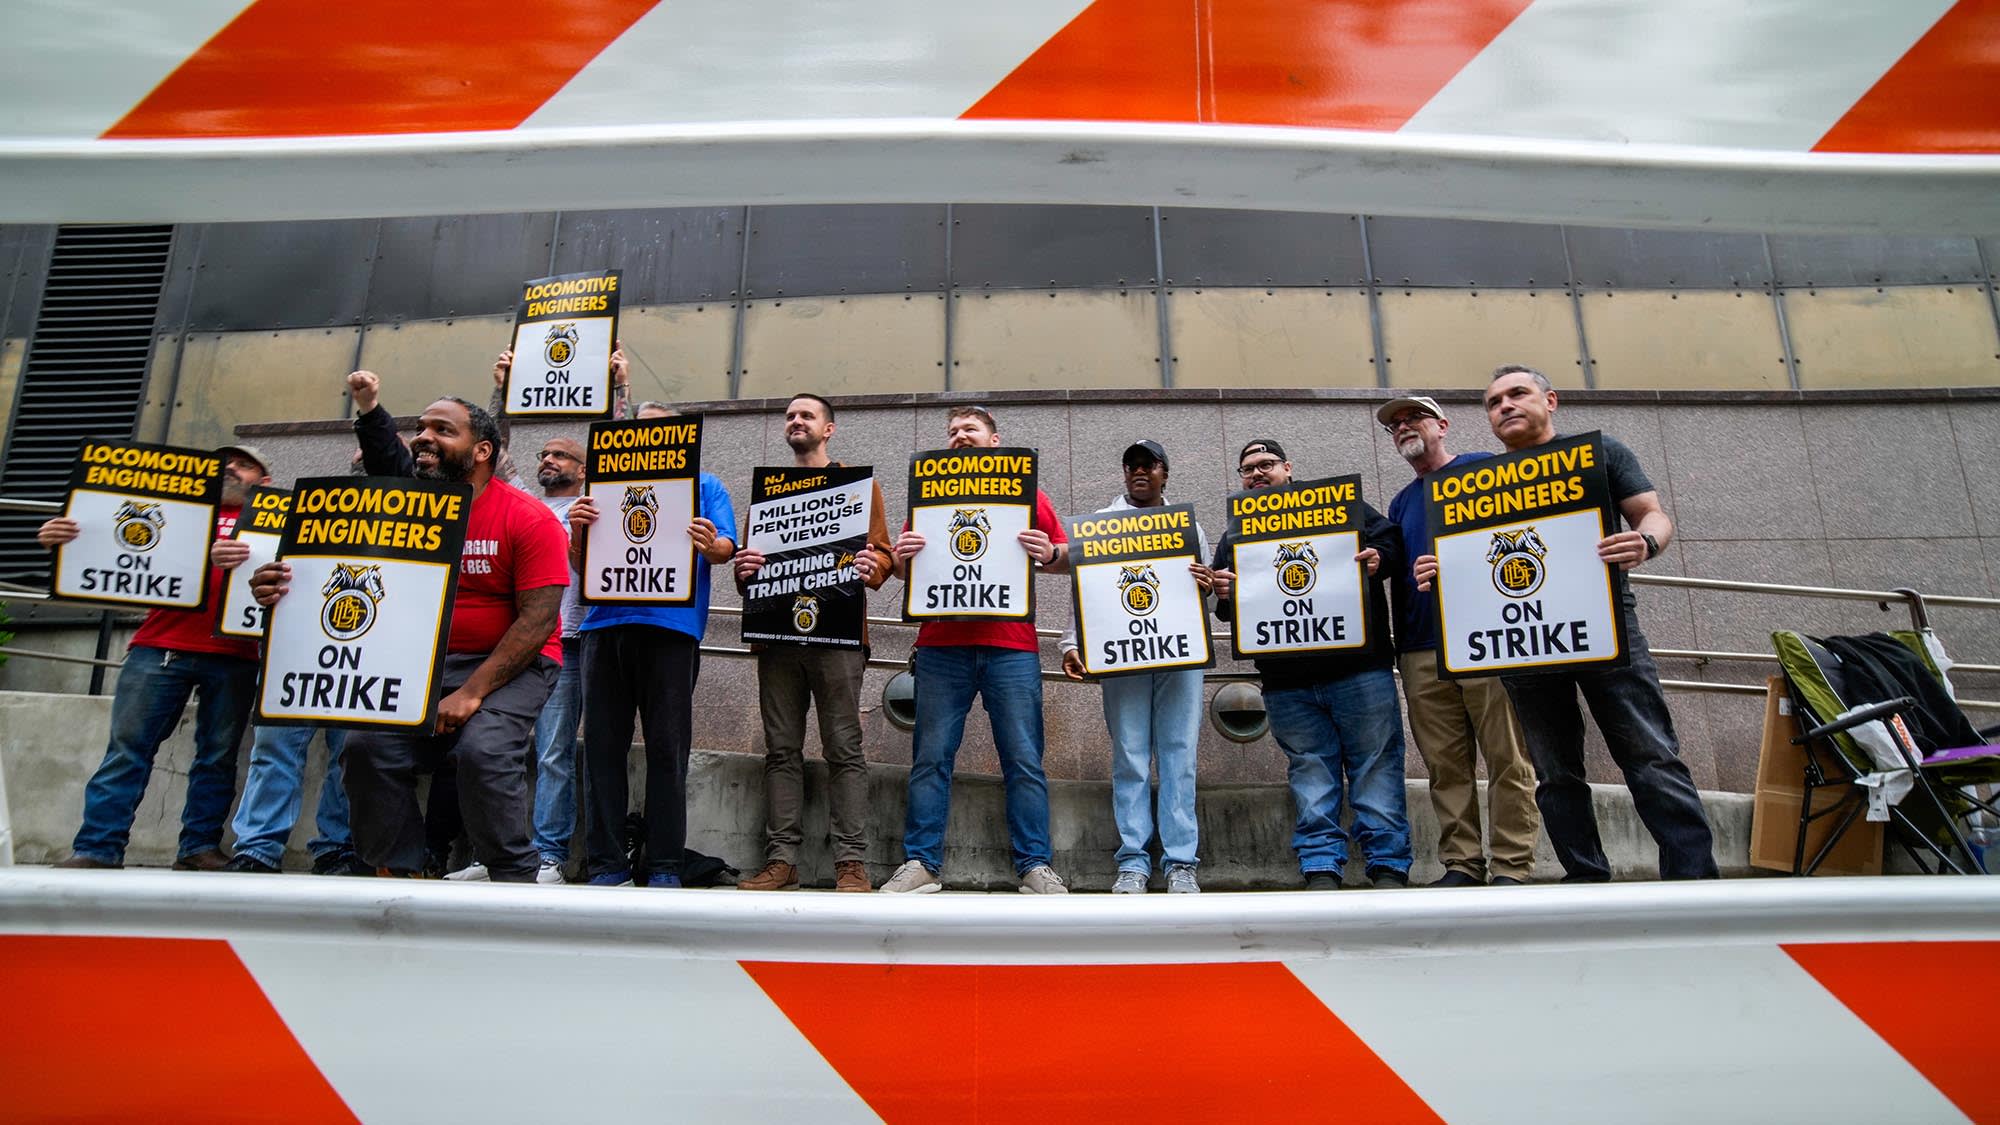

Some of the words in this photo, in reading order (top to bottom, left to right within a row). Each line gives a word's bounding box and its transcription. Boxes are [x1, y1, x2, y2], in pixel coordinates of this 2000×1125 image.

[525, 276, 617, 301] LOCOMOTIVE
[528, 295, 607, 317] ENGINEERS
[546, 370, 569, 384] ON
[521, 387, 592, 407] STRIKE
[593, 424, 696, 449] LOCOMOTIVE
[83, 445, 219, 476] LOCOMOTIVE
[598, 449, 686, 473] ENGINEERS
[915, 456, 1031, 477] LOCOMOTIVE
[1433, 444, 1594, 501] LOCOMOTIVE
[86, 466, 206, 496] ENGINEERS
[764, 473, 785, 485] NJ
[764, 476, 827, 496] TRANSIT:
[922, 478, 1022, 498] ENGINEERS
[296, 488, 461, 520] LOCOMOTIVE
[759, 493, 846, 520] MILLIONS
[1233, 483, 1355, 516] LOCOMOTIVE
[1444, 476, 1584, 525] ENGINEERS
[752, 502, 863, 536] PENTHOUSE
[1073, 511, 1190, 538] LOCOMOTIVE
[1242, 506, 1347, 535] ENGINEERS
[297, 519, 442, 550] ENGINEERS
[780, 523, 840, 544] VIEWS
[1083, 532, 1184, 557] ENGINEERS
[117, 554, 151, 571] ON
[467, 559, 491, 574] BEG
[626, 547, 651, 565] ON
[758, 552, 835, 580] NOTHING
[838, 552, 855, 570] for
[80, 568, 182, 598] STRIKE
[600, 567, 675, 592] STRIKE
[747, 578, 800, 600] TRAIN
[803, 565, 861, 590] CREWS
[953, 565, 981, 581] ON
[926, 584, 1009, 608] STRIKE
[1283, 598, 1313, 617] ON
[1502, 600, 1543, 624] ON
[1129, 618, 1157, 635] ON
[1257, 616, 1345, 645] STRIKE
[1104, 635, 1189, 664] STRIKE
[1468, 620, 1589, 661] STRIKE
[318, 645, 361, 670] ON
[280, 672, 401, 712] STRIKE
